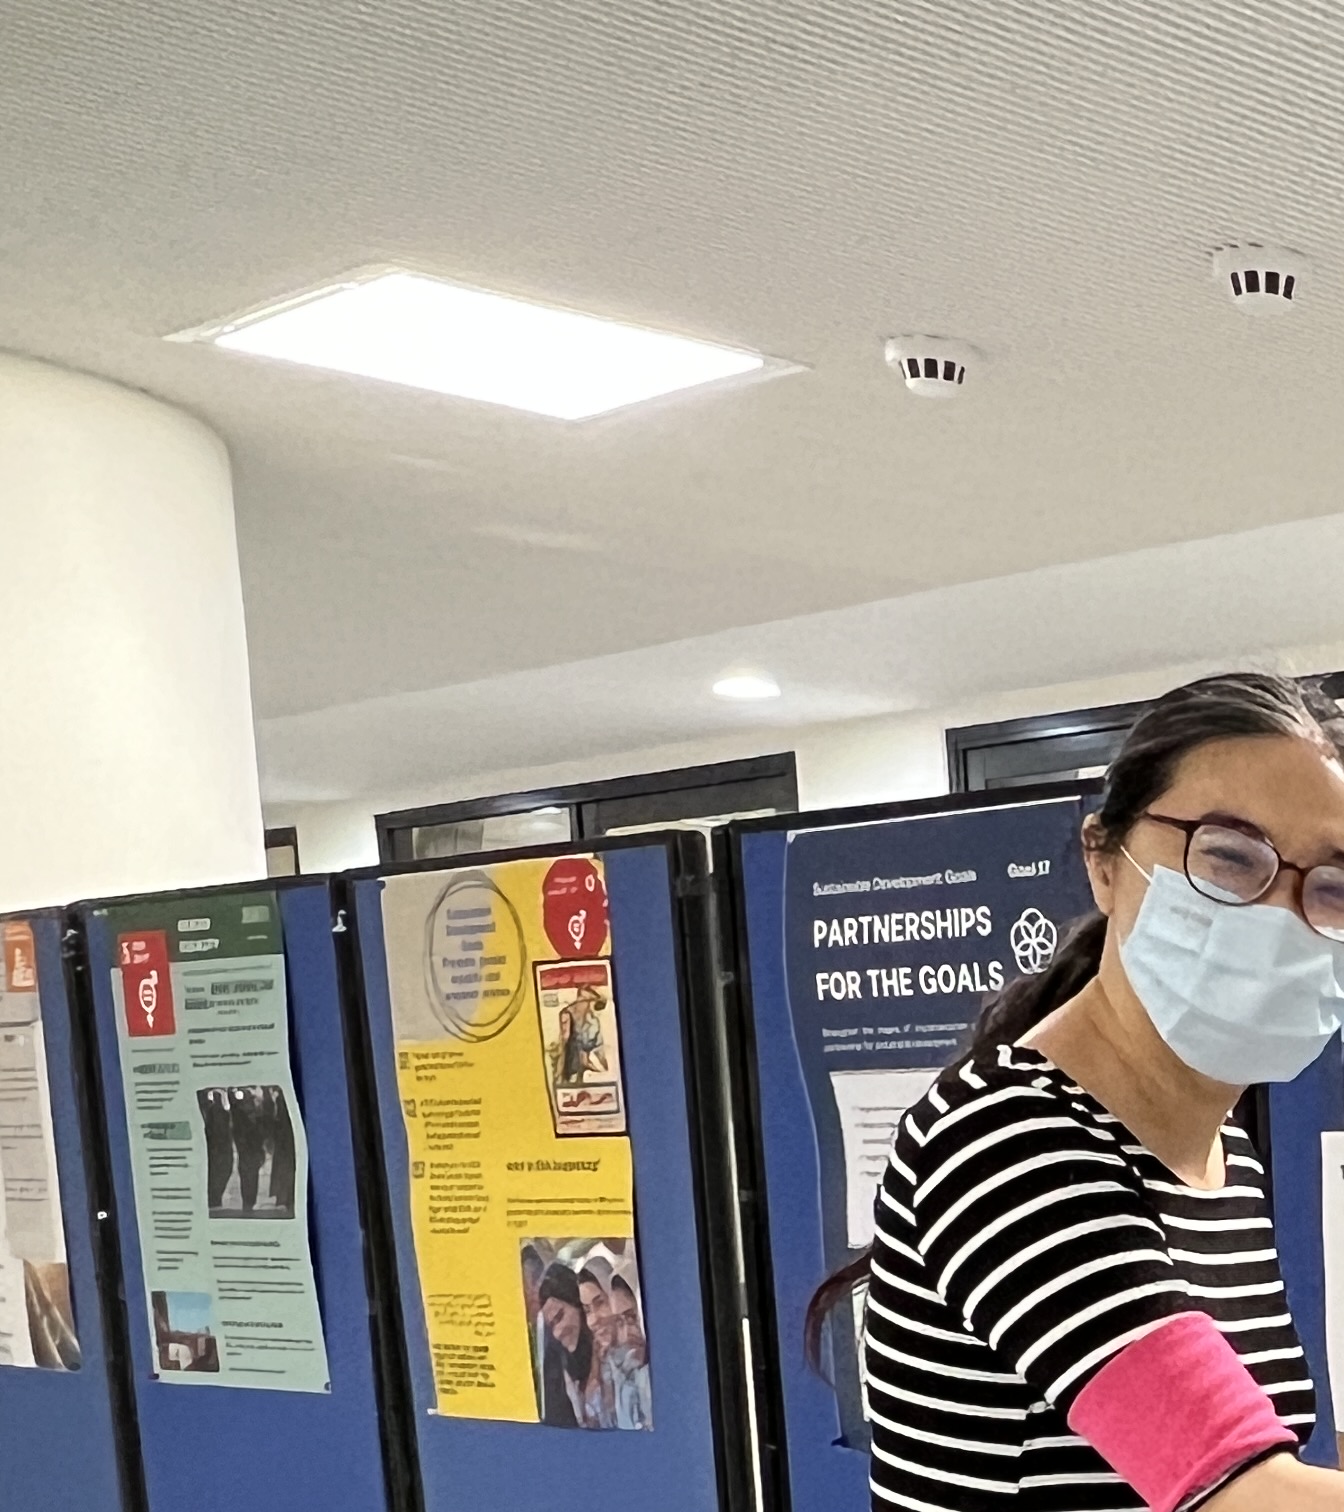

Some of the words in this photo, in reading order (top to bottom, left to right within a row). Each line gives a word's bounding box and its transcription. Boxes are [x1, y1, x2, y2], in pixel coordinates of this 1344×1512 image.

[814, 906, 992, 948] PARTNERSHIPS
[816, 971, 862, 1001] FOR
[866, 967, 914, 998] THE
[918, 960, 1005, 995] GOALS
